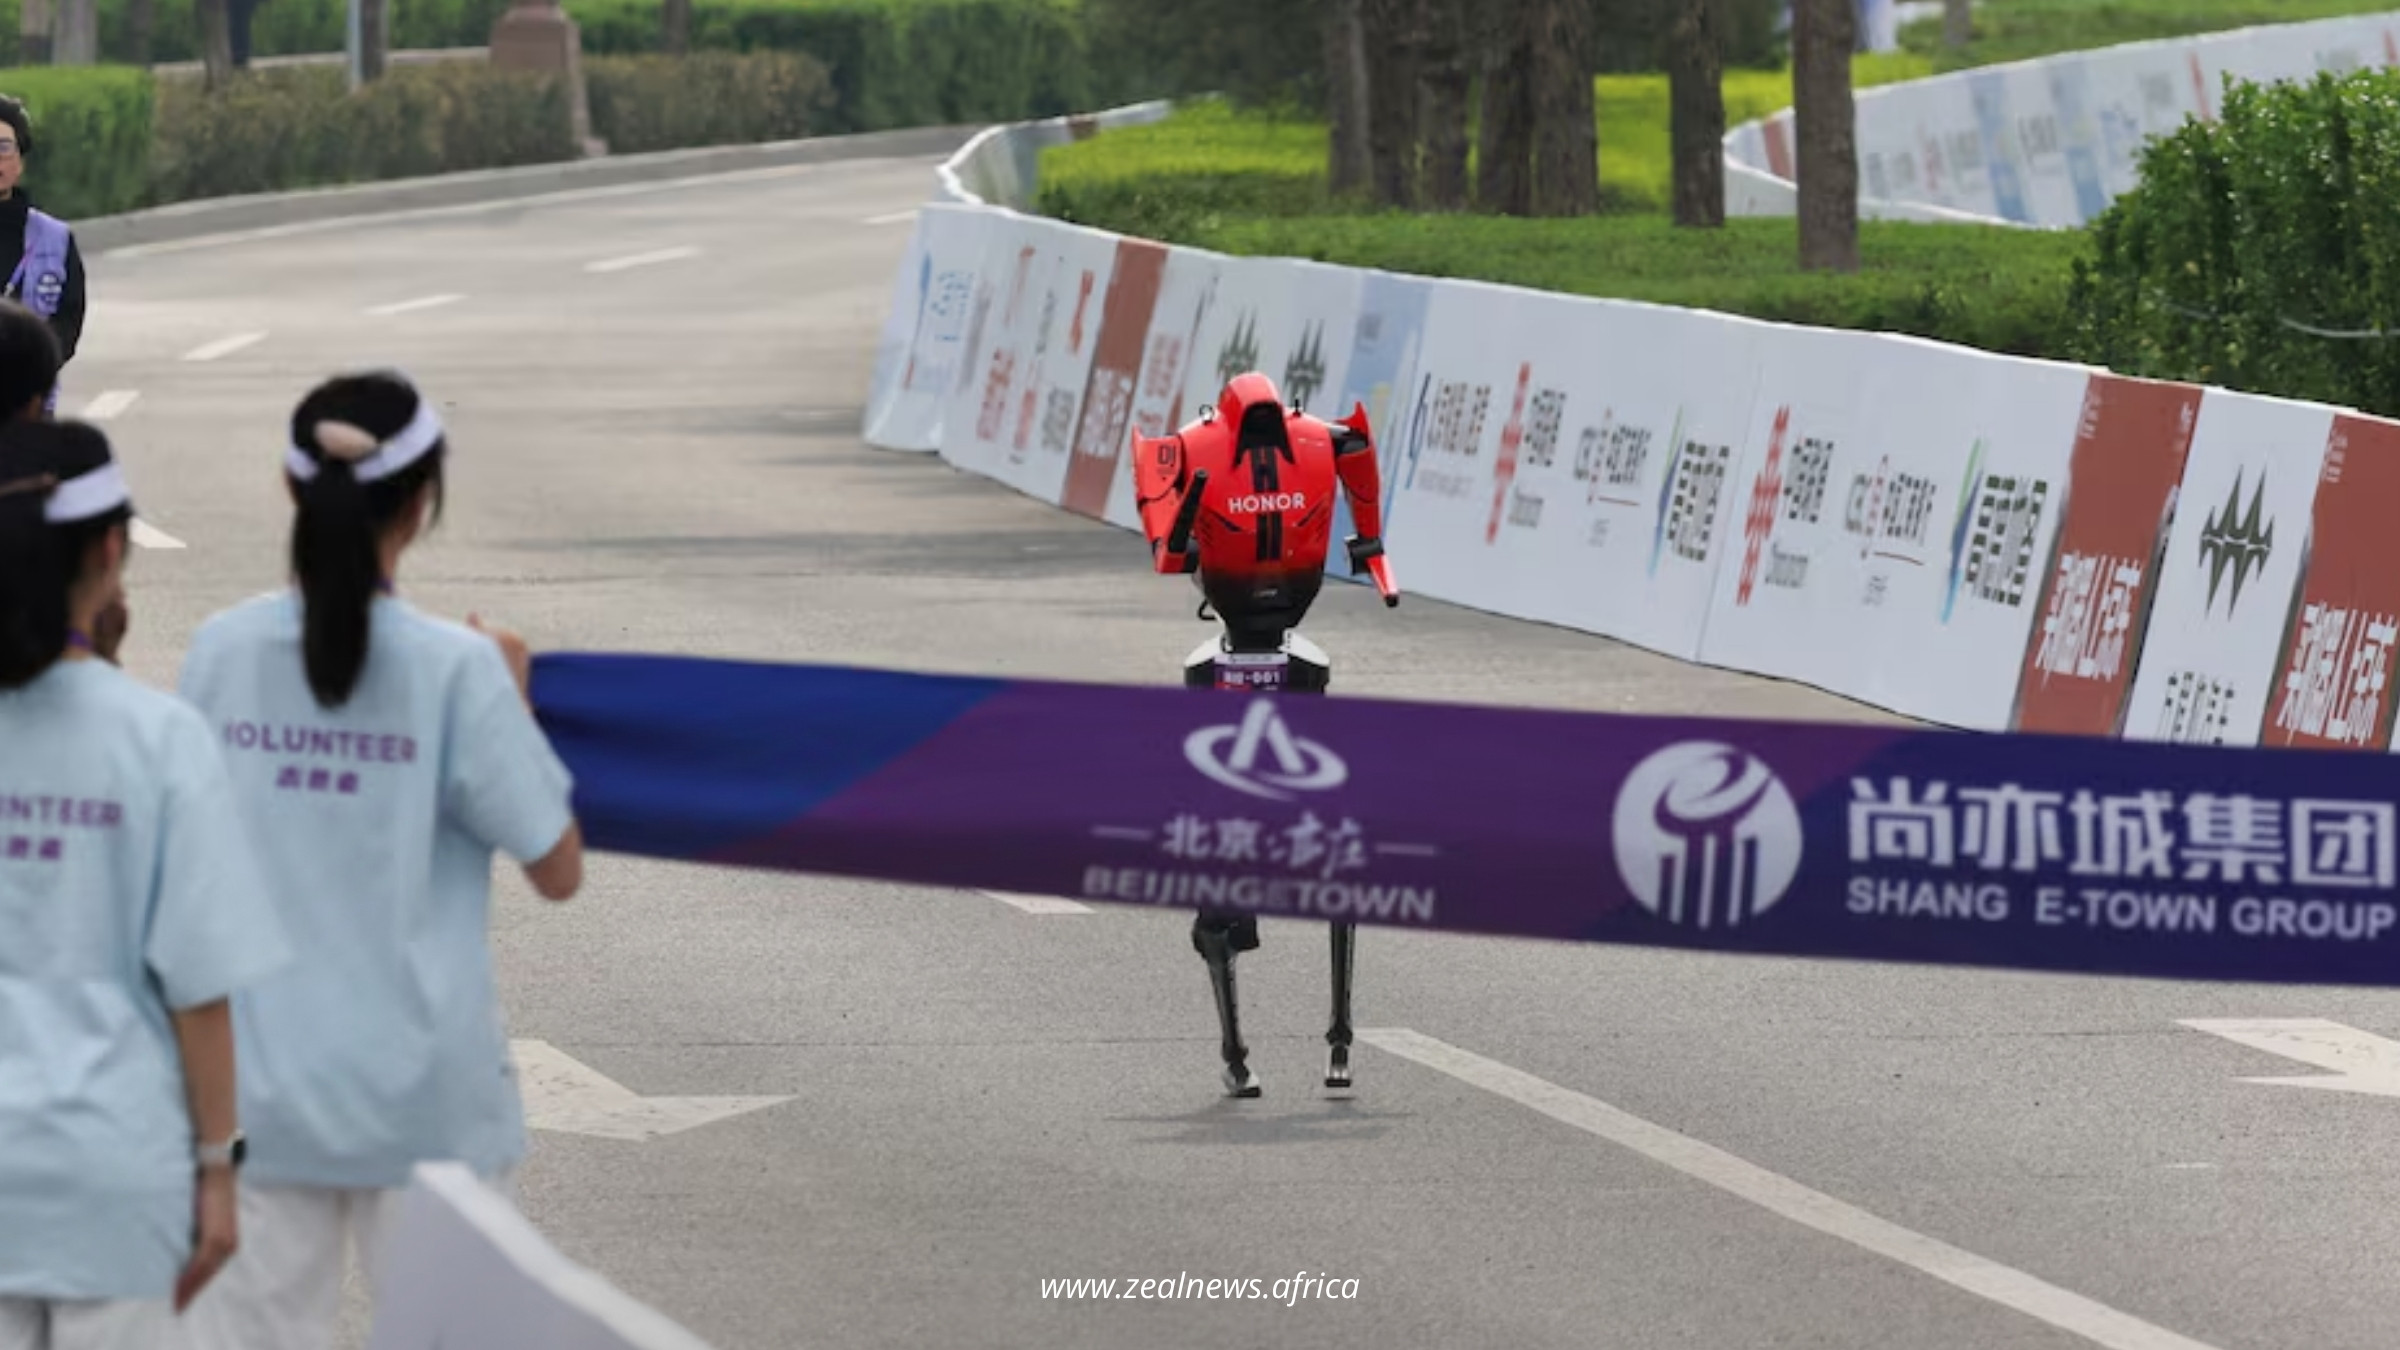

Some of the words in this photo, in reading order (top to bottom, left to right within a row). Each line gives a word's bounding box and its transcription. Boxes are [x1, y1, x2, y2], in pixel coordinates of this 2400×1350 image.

[1228, 492, 1307, 514] HONOR
[1848, 777, 2395, 888] 尚亦城集团
[1847, 875, 2008, 921] SHANG
[2036, 886, 2217, 933] E-TOWN
[2231, 897, 2397, 940] GROUP
